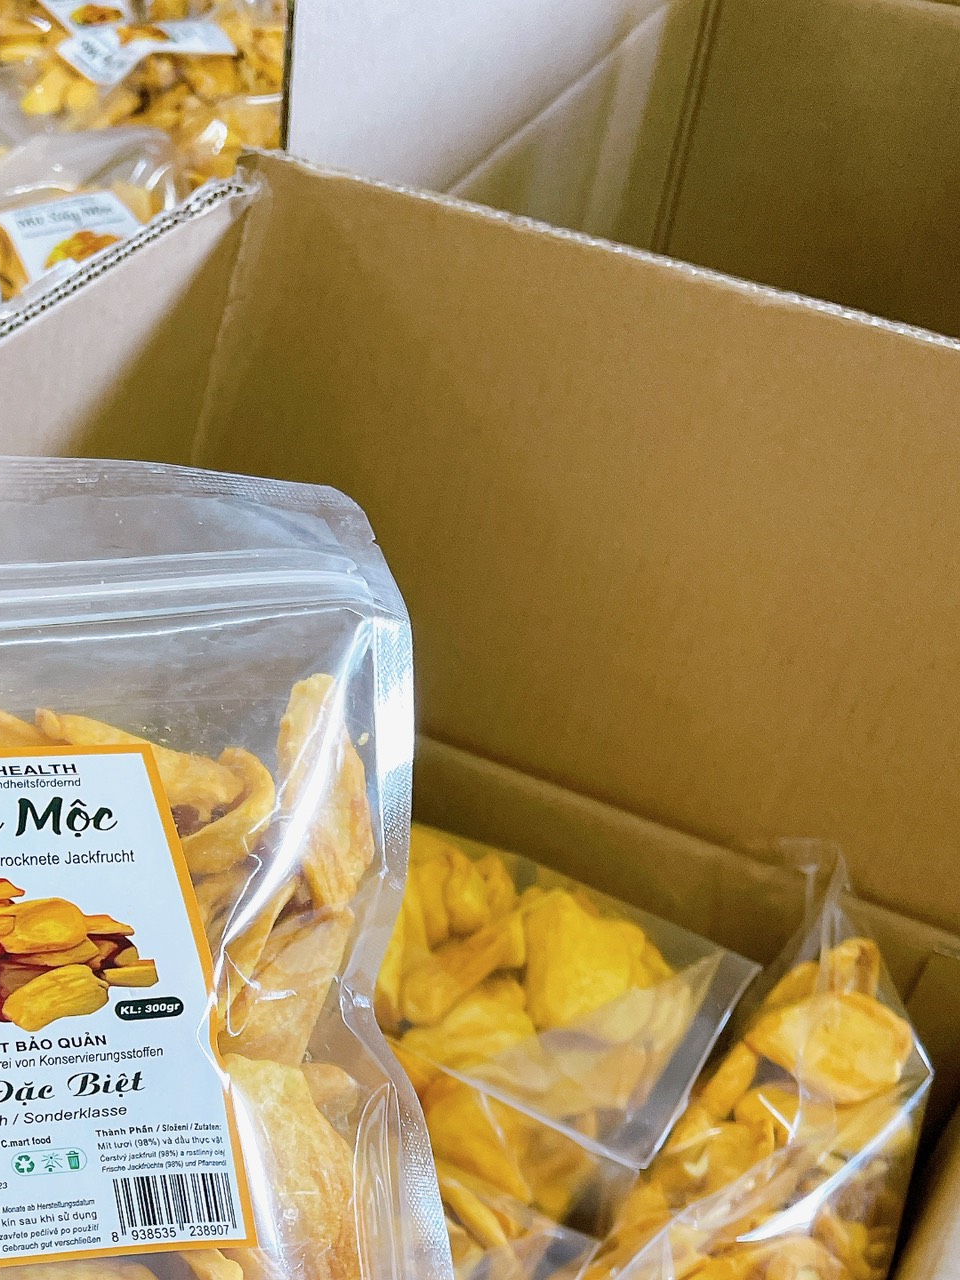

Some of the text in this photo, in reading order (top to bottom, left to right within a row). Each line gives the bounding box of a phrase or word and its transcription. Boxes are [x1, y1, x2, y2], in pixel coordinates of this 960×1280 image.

[14, 795, 118, 838] Mộc
[63, 848, 135, 865] Jackfrucht
[121, 1003, 180, 1015] KL: 300gr
[14, 1035, 53, 1052] BẢO
[56, 1030, 107, 1049] QUẢN
[14, 1057, 36, 1068] von
[38, 1045, 163, 1067] Konservierungsstoffen
[66, 1070, 146, 1098] Biệt
[22, 1105, 127, 1124] Sonderklasse
[0, 1137, 31, 1148] C.mart
[30, 1134, 51, 1145] food
[96, 1141, 112, 1150] Mít
[0, 1217, 17, 1227] kín
[18, 1216, 37, 1226] sau
[38, 1213, 55, 1224] khi
[56, 1210, 70, 1222] sử
[71, 1210, 98, 1222] dụng
[111, 1224, 230, 1242] 8 938535 238907
